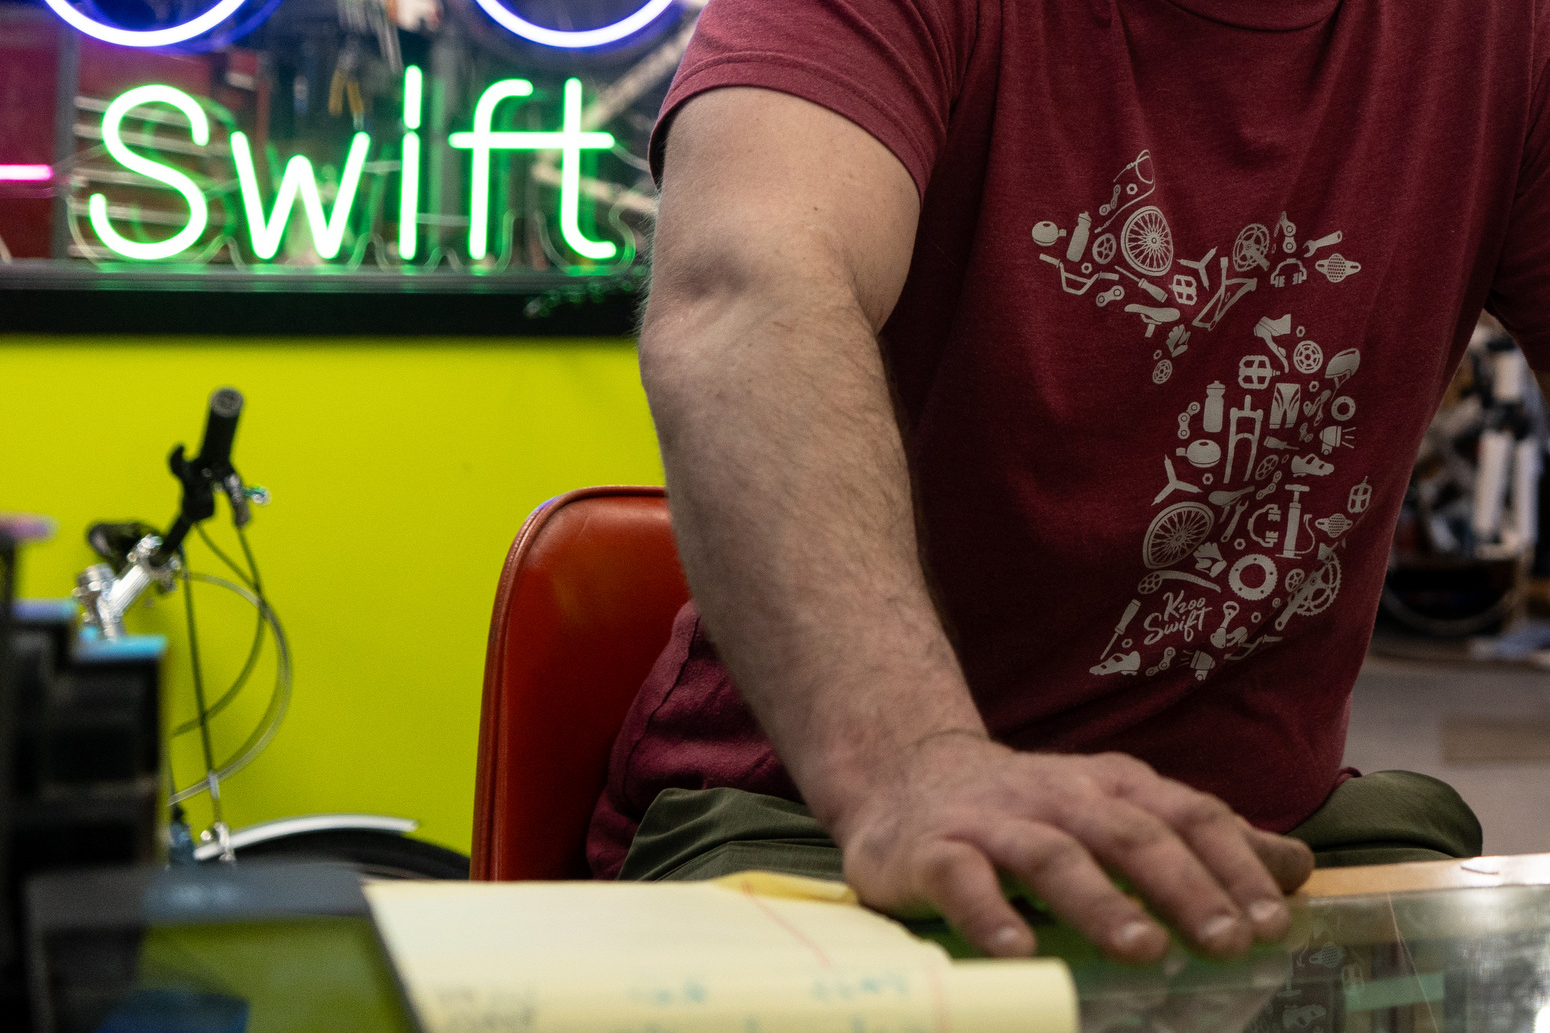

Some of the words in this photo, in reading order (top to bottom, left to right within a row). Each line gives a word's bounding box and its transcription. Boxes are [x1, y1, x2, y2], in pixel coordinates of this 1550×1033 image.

[88, 64, 618, 262] Swift
[1162, 589, 1206, 621] Kzoo
[1143, 607, 1213, 646] Swift
